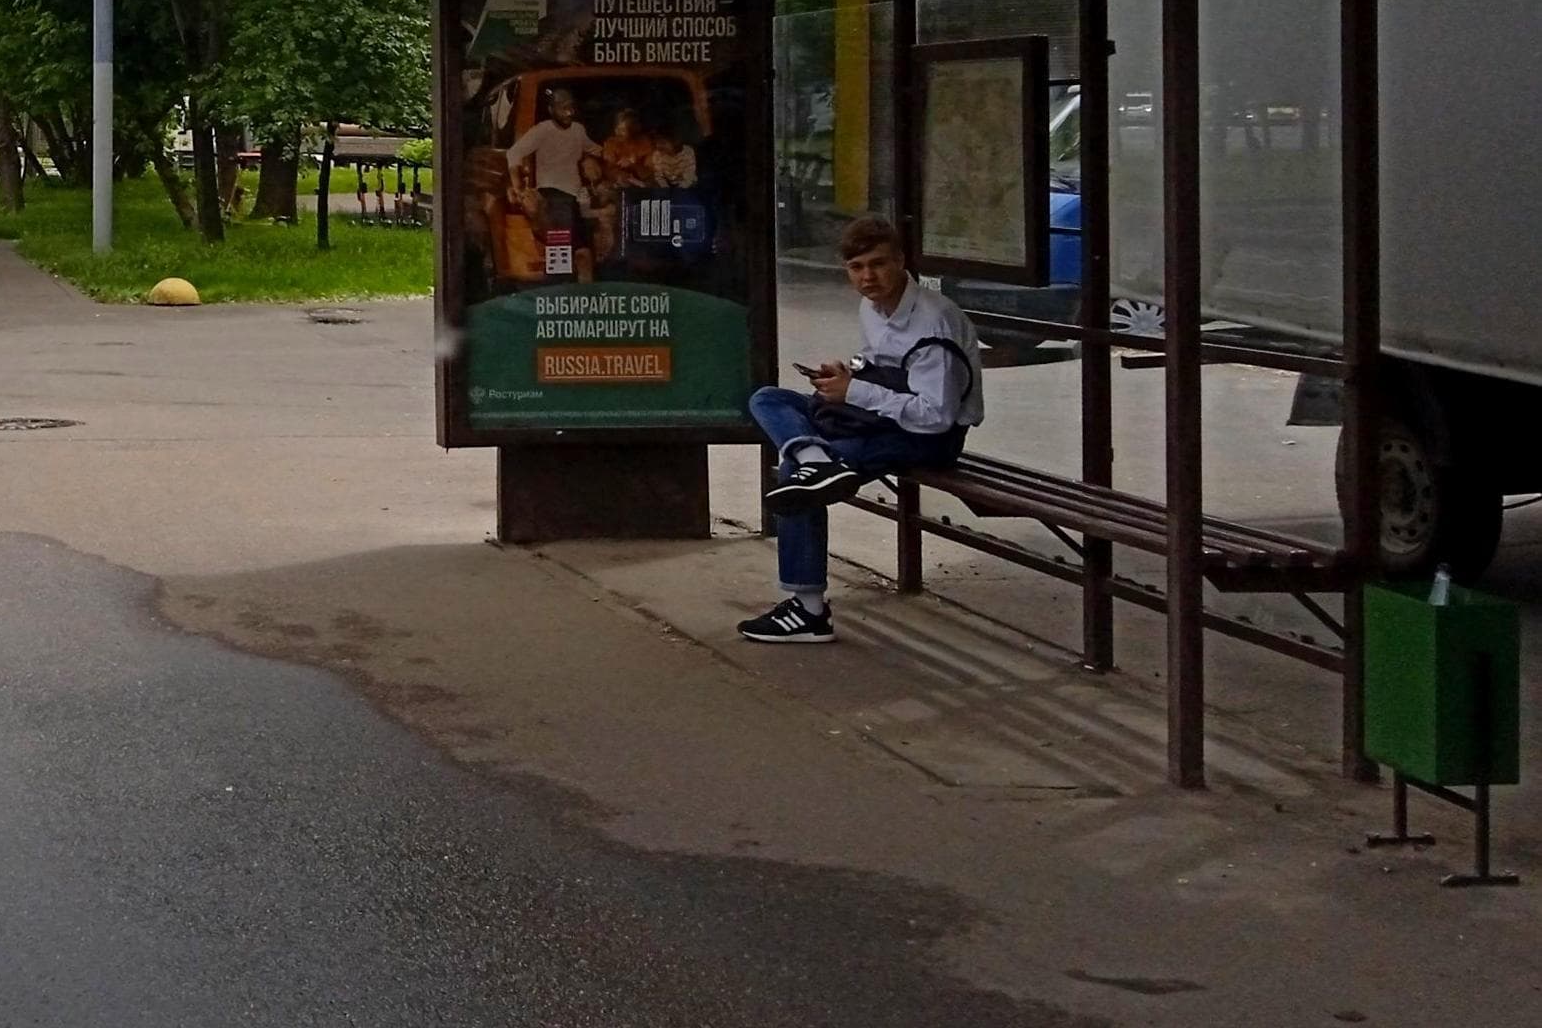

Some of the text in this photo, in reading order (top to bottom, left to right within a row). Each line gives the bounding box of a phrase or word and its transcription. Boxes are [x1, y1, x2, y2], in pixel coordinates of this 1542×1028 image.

[593, 14, 737, 38] ЛУЧШИЙ СПОСОБ
[594, 41, 712, 63] БЫТЬ ВМЕСТЕ
[535, 292, 670, 315] ВЫБИРАЙТЕ СВОЙ
[536, 318, 670, 339] АВТОМАРШРУТ НА
[544, 354, 664, 376] RUSSIA.TRAVEL
[488, 388, 544, 401] Ростуризм
